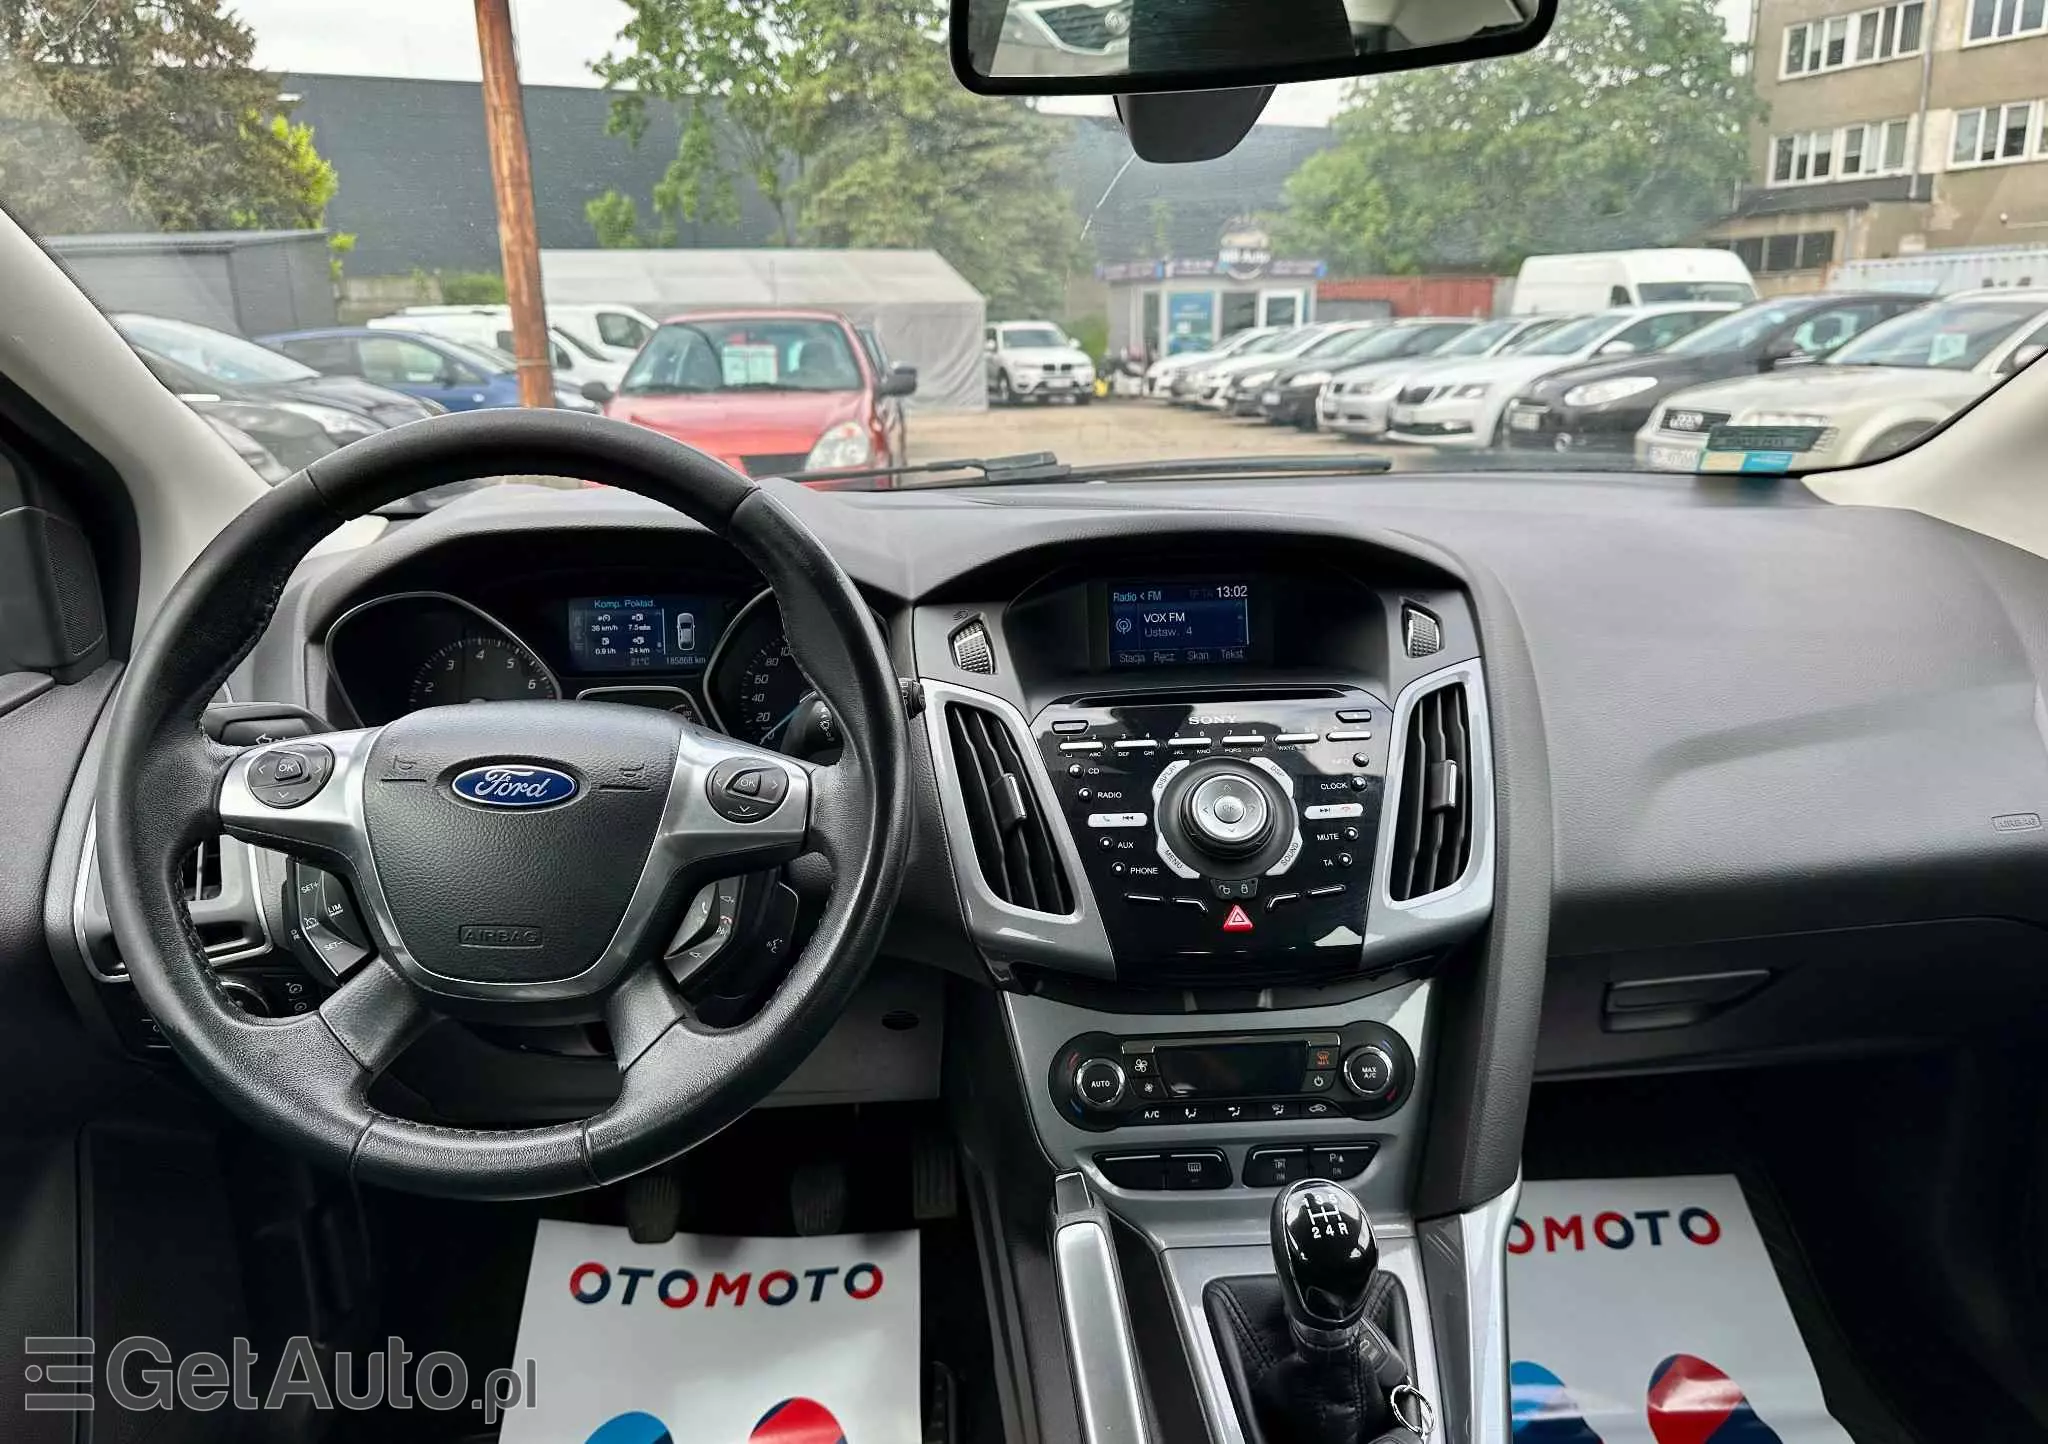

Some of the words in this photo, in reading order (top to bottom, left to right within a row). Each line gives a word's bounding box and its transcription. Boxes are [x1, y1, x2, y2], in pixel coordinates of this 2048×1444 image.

[1113, 592, 1137, 603] Radio
[1147, 590, 1162, 601] FM
[1216, 585, 1248, 598] 13:02
[594, 600, 622, 609] Komp.
[1144, 612, 1167, 623] VOX
[1168, 611, 1185, 622] FM
[601, 624, 618, 632] km/h
[1186, 626, 1192, 635] 4
[475, 650, 485, 660] 4
[1187, 651, 1208, 661] Skan
[1222, 649, 1243, 660] Tekst
[445, 660, 455, 671] 3
[506, 658, 515, 669] 5
[695, 656, 706, 665] km
[765, 657, 779, 667] 80
[753, 674, 769, 685] 60
[424, 682, 434, 692] 2
[527, 680, 536, 690] 6
[752, 692, 765, 702] 40
[755, 712, 771, 722] 20
[1188, 716, 1237, 725] SONY
[279, 763, 294, 772] OK
[1088, 767, 1100, 775] CD
[474, 769, 551, 797] Ford
[740, 778, 756, 788] OK
[1321, 782, 1348, 790] CLOCK
[1097, 791, 1122, 799] RADIO
[1317, 832, 1340, 841] MUTE
[1118, 841, 1134, 849] AUX
[1165, 849, 1183, 869] MENU
[1281, 842, 1299, 866] SOUND
[1323, 859, 1334, 867] TA
[1130, 867, 1160, 875] PHONE
[300, 881, 319, 894] SET+
[328, 903, 343, 913] LIM
[463, 928, 538, 943] AIRBAG
[1091, 1080, 1111, 1088] AUTO
[1144, 1110, 1160, 1119] A/C
[1312, 1226, 1321, 1239] 2
[1326, 1224, 1335, 1236] 4
[1338, 1221, 1349, 1235] R
[569, 1261, 884, 1309] OTOMOTO
